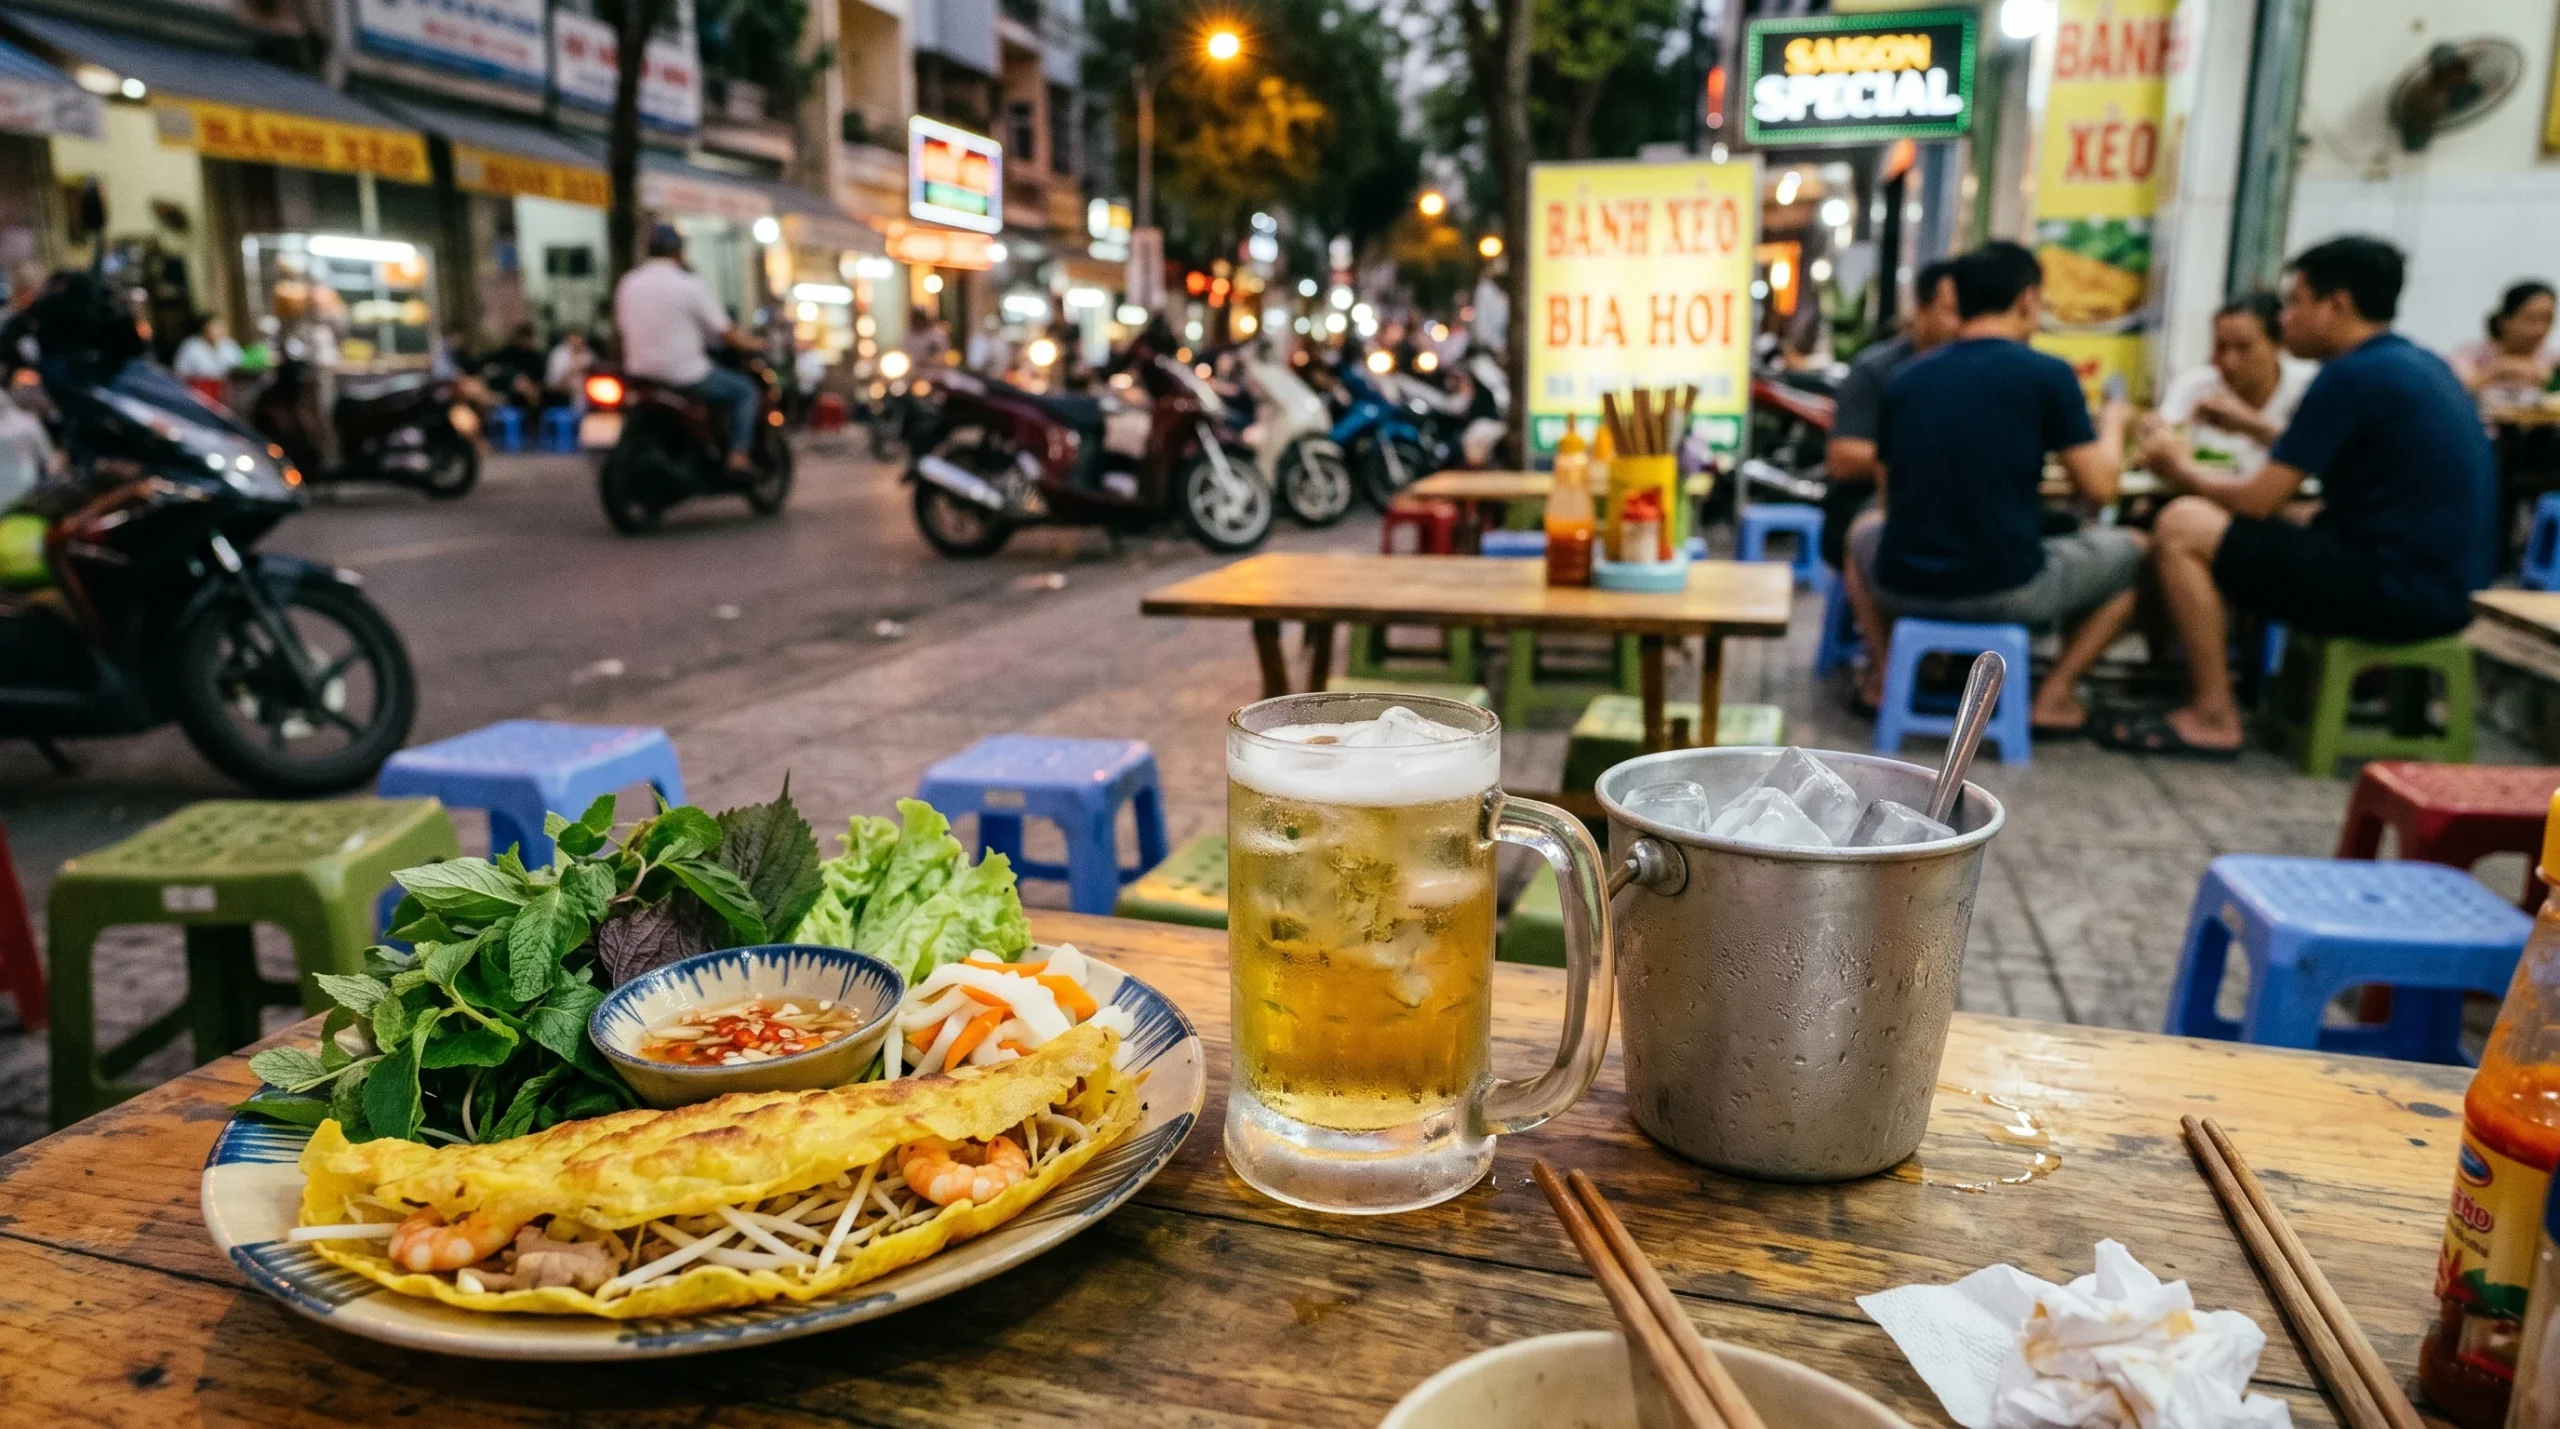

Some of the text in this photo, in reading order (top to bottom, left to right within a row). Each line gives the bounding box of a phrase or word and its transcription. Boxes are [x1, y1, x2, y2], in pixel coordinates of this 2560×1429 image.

[1784, 33, 1932, 75] SAIGON
[1752, 67, 1964, 122] SPECIAL
[1547, 292, 1733, 347] BIA HOI
